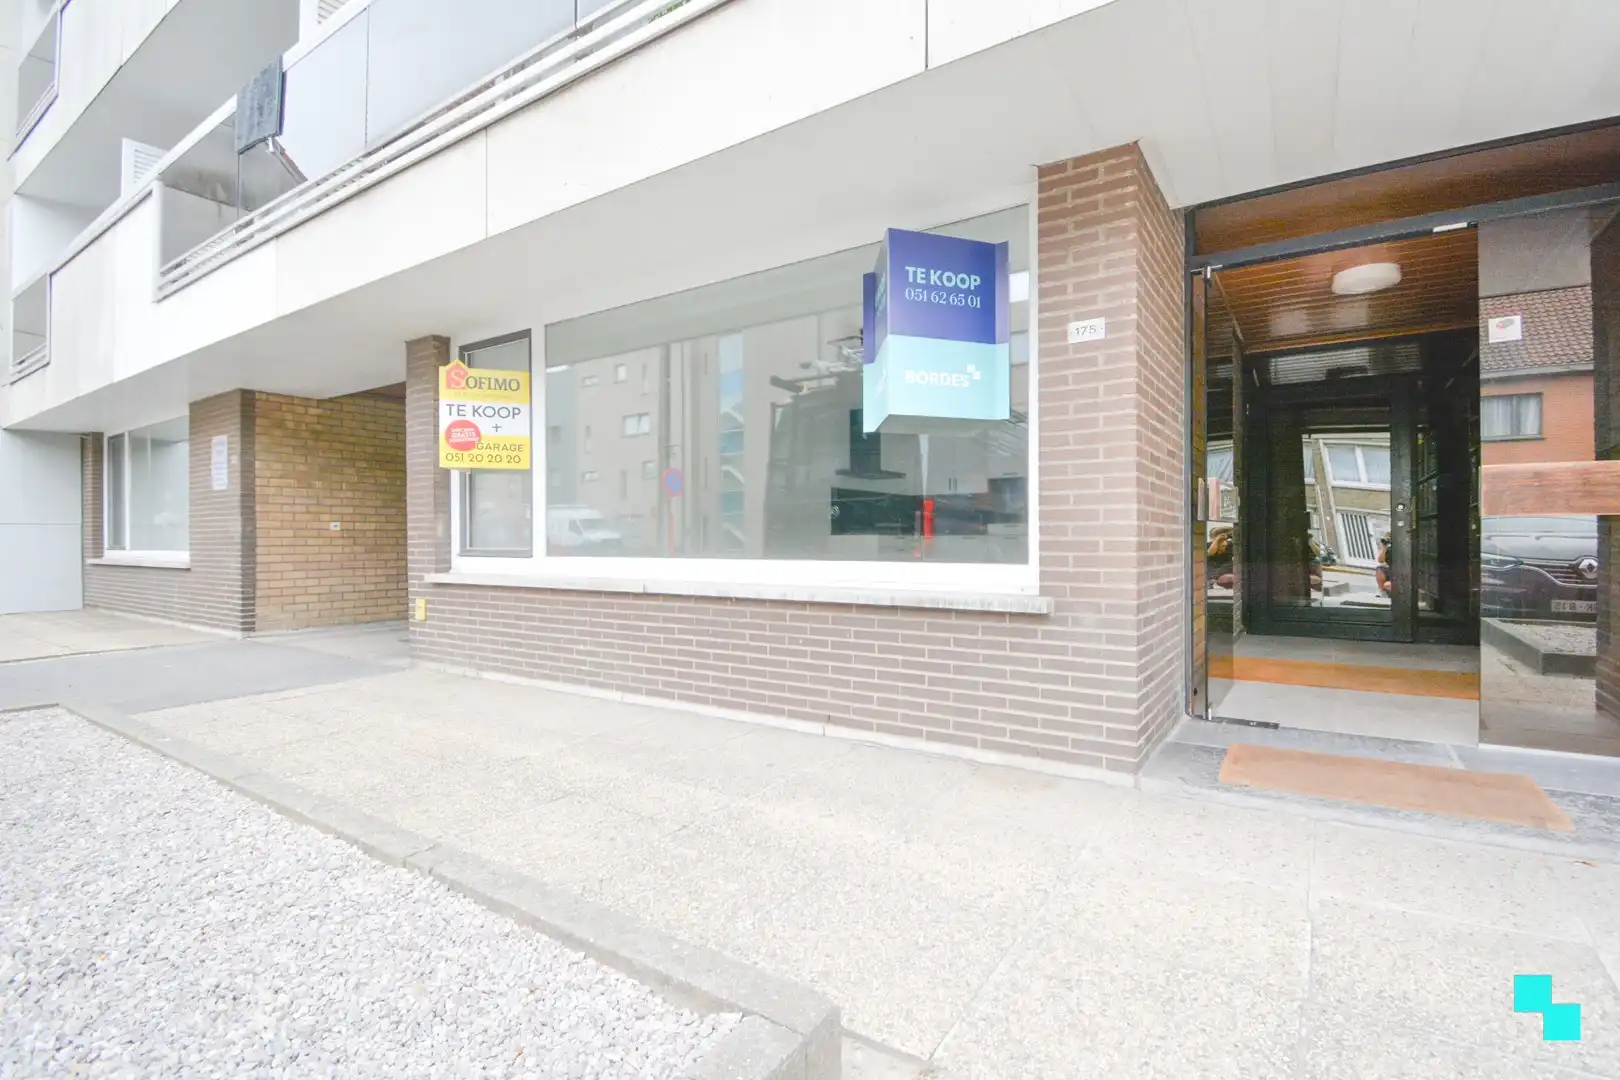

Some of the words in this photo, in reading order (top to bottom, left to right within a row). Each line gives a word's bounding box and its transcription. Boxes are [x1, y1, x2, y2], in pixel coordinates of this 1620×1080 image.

[905, 266, 926, 284] TE
[930, 269, 981, 290] KOOP
[905, 288, 927, 302] 051
[931, 291, 947, 304] 62
[949, 293, 965, 307] 65
[968, 295, 981, 308] 01
[1075, 324, 1097, 336] 175
[451, 370, 521, 392] SOFIMO
[905, 370, 970, 388] BORDES
[445, 404, 467, 417] TE
[472, 405, 522, 419] KOOP
[492, 423, 502, 433] +
[476, 443, 525, 452] GARAGE
[445, 452, 464, 462] 051
[468, 453, 484, 463] 20
[487, 454, 503, 463] 20
[506, 455, 521, 464] 20
